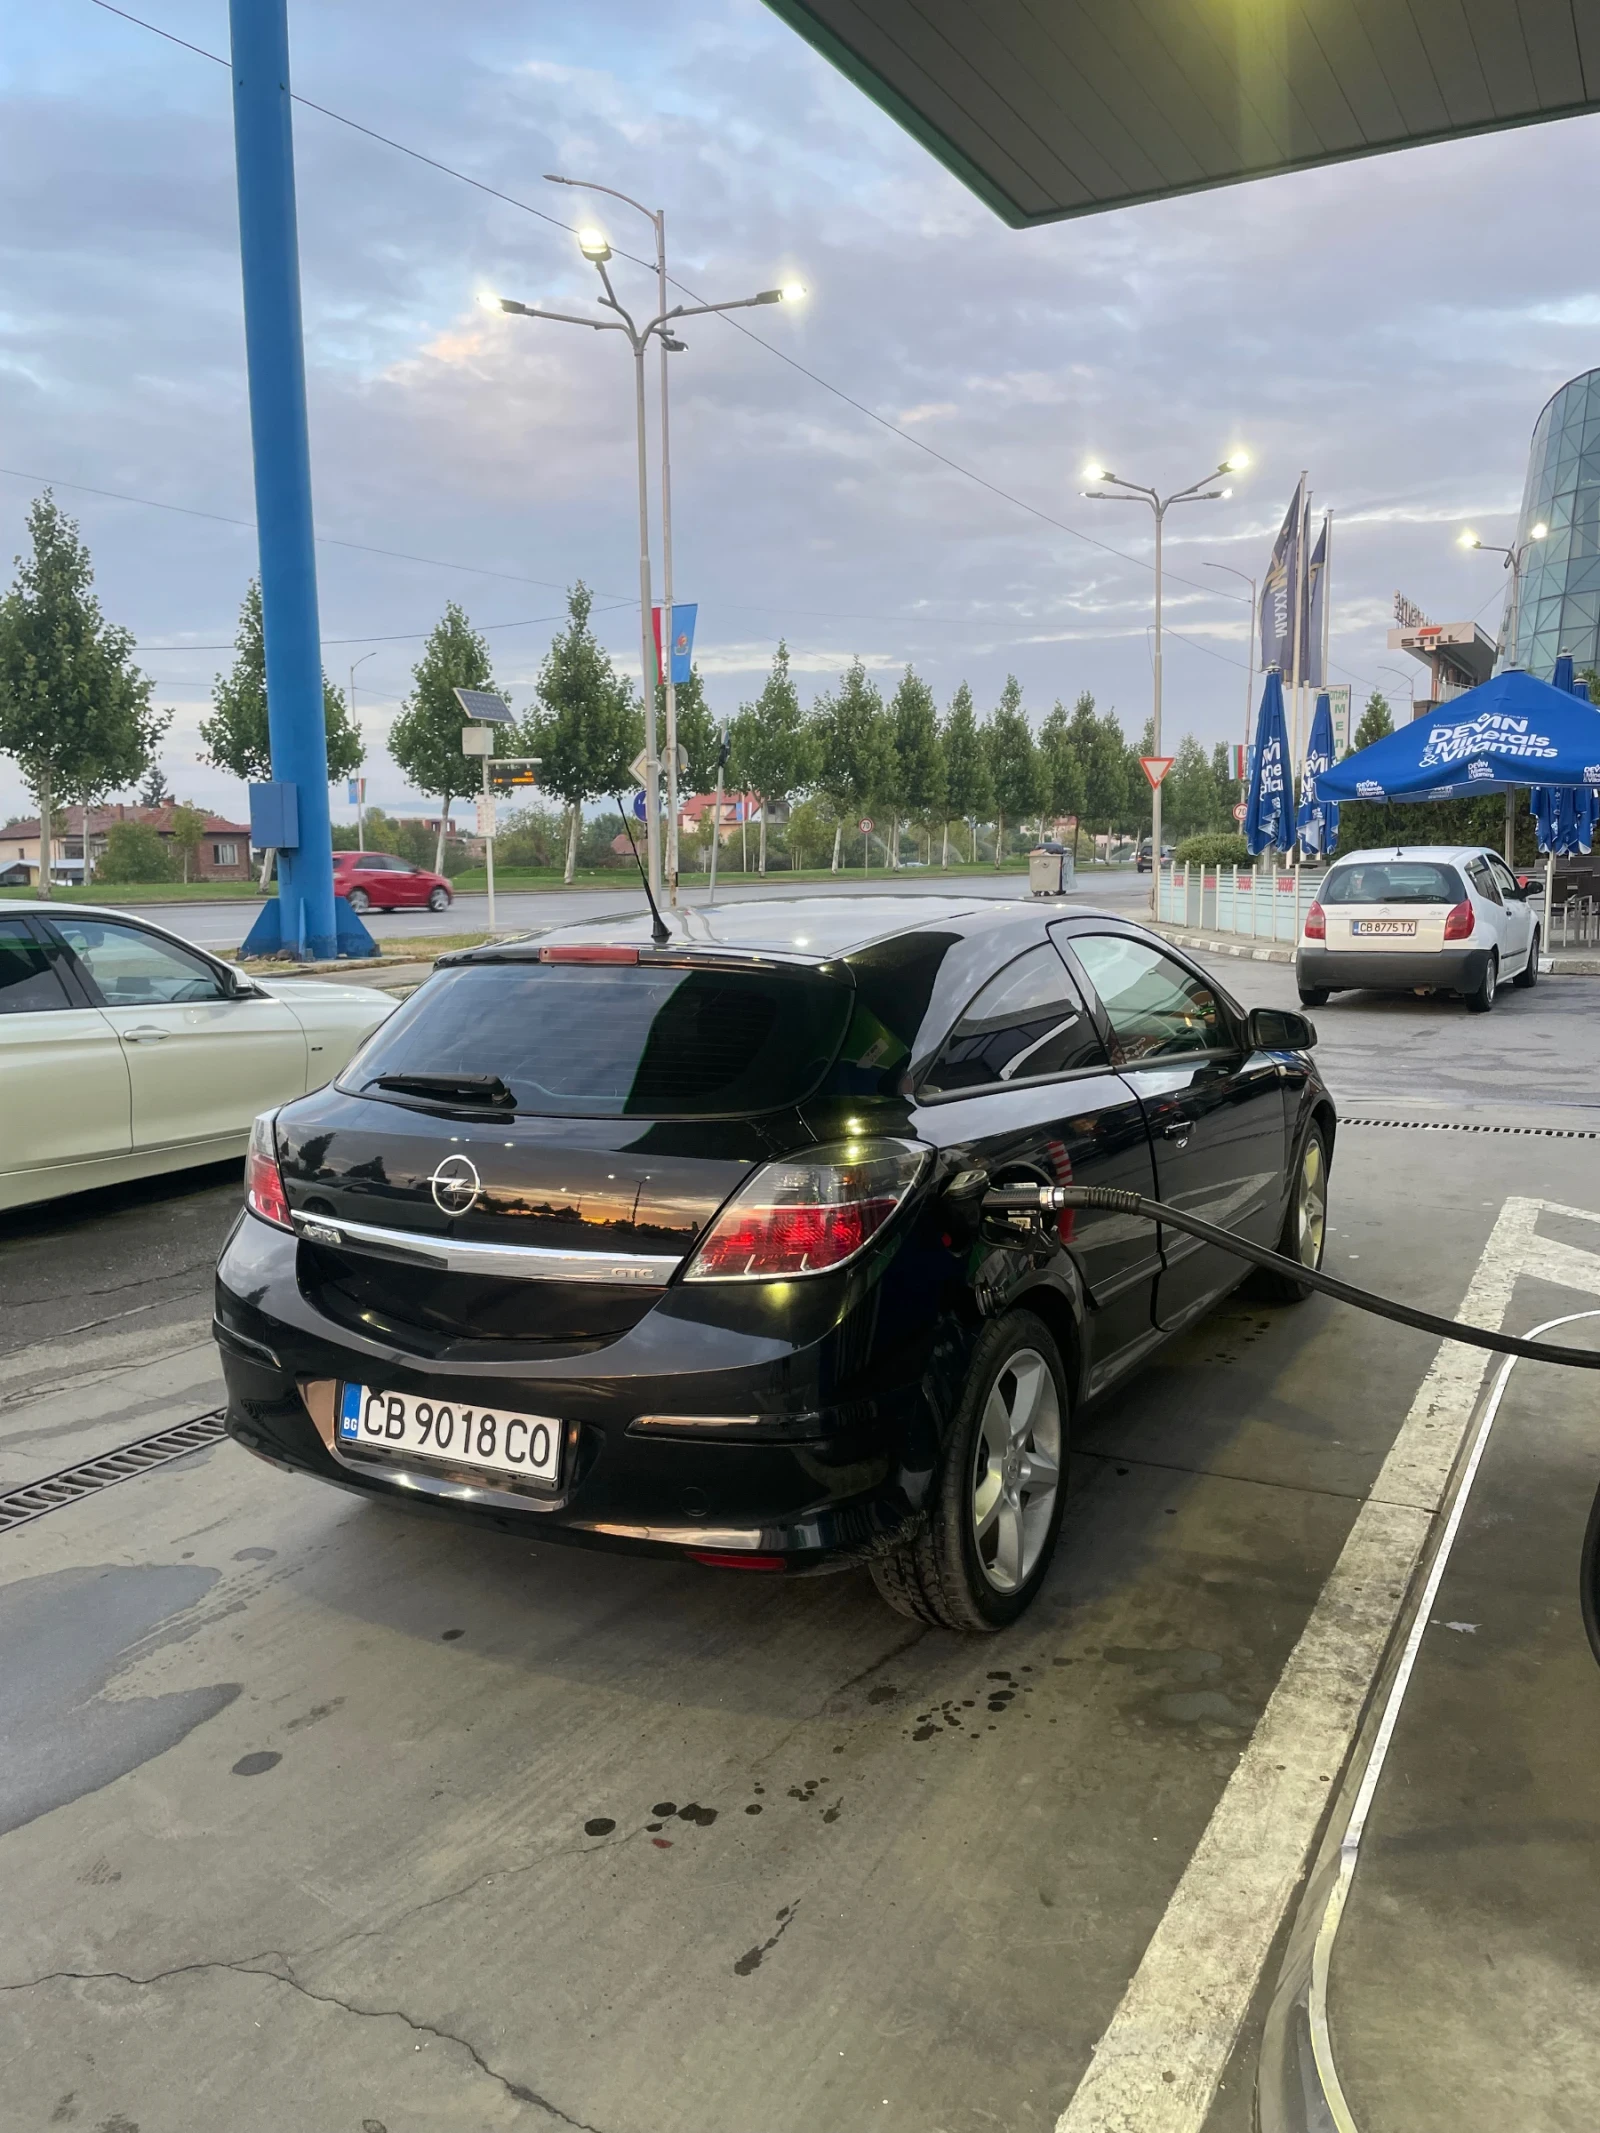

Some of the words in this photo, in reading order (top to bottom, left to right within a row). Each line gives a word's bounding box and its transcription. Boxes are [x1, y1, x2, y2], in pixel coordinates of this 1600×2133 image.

[1401, 635, 1459, 647] STILL
[1429, 714, 1528, 743] DEVIN
[1435, 730, 1550, 754] Minerals
[1419, 754, 1439, 767] &
[1442, 741, 1558, 762] Vitamins
[1468, 760, 1488, 770] DEVIN
[1356, 780, 1378, 788] DEVIN
[1360, 923, 1373, 932] CB
[1374, 923, 1399, 932] 8775
[1401, 923, 1414, 932] TX
[303, 1224, 342, 1243] ASTRA
[611, 1267, 654, 1279] GTC
[343, 1417, 357, 1431] BG
[364, 1395, 406, 1440] CB
[415, 1402, 497, 1457] 9018
[505, 1418, 550, 1467] CO
